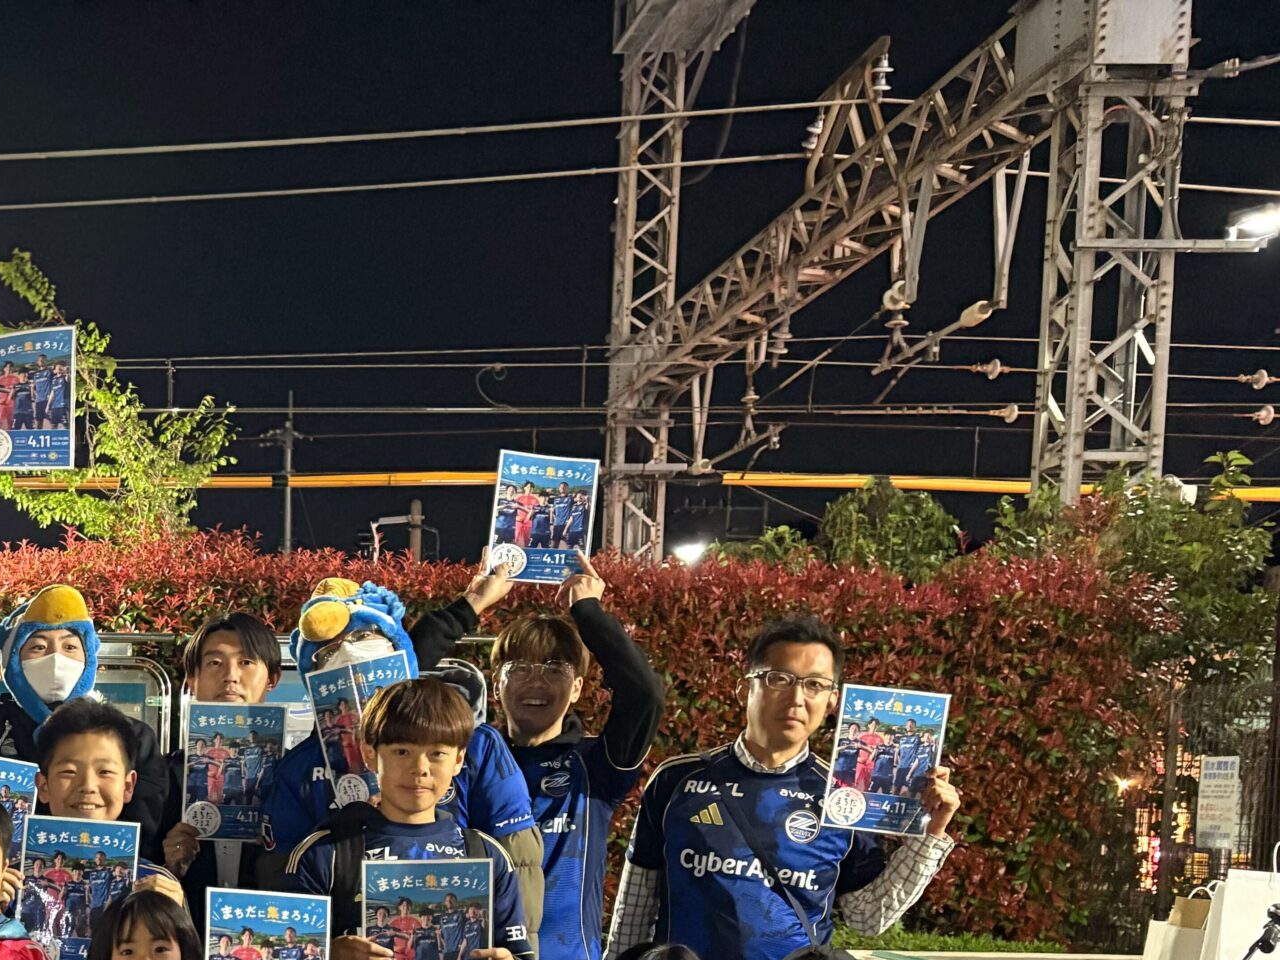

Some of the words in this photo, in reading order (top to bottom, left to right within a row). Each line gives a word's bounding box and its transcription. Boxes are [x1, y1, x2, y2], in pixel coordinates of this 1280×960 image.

[28, 435, 51, 448] 4.11
[543, 553, 566, 564] 4.11
[779, 788, 815, 802] avex
[882, 800, 906, 814] 4.11
[236, 810, 258, 823] 4.11
[37, 831, 127, 850] まちだに集まろう!
[425, 843, 465, 857] avex
[377, 874, 479, 892] まちだに集まろう!
[220, 904, 317, 925] まちだに集まろう!
